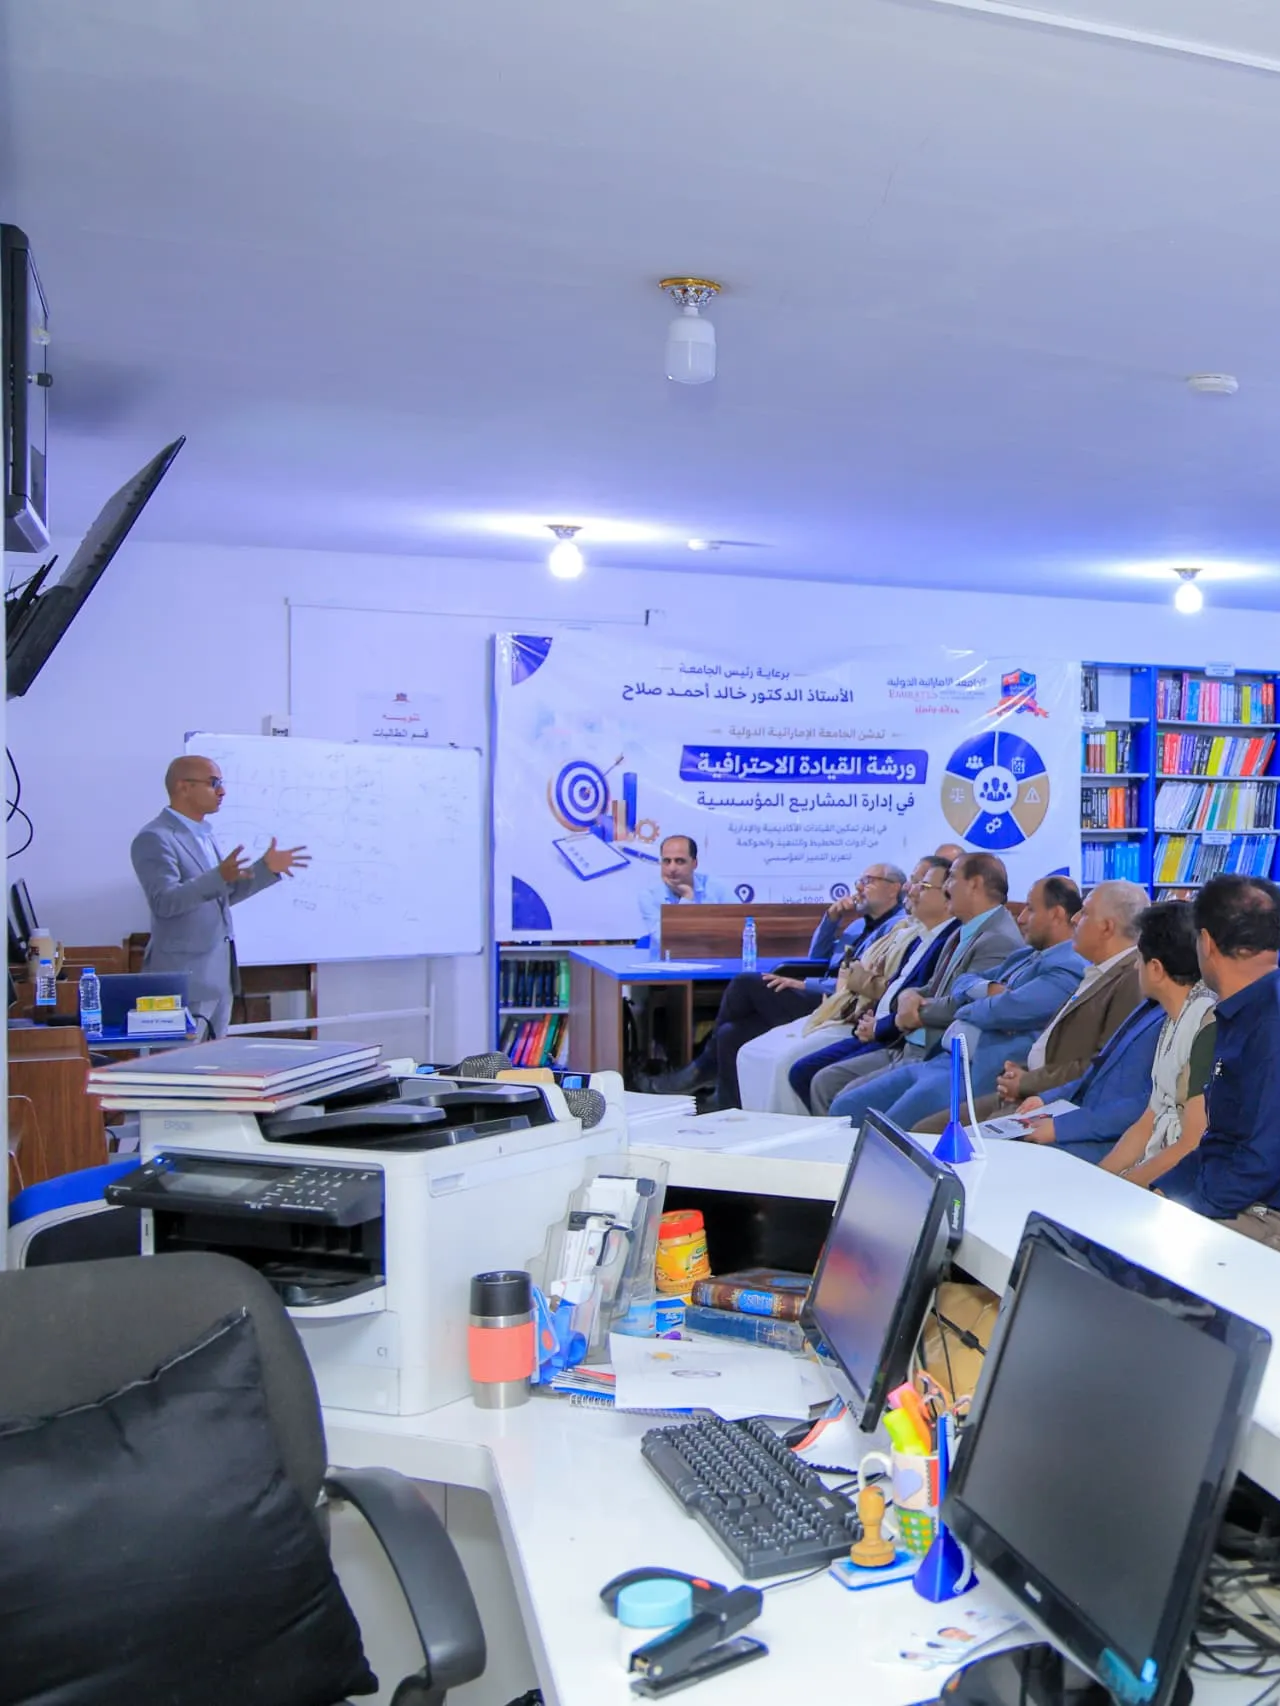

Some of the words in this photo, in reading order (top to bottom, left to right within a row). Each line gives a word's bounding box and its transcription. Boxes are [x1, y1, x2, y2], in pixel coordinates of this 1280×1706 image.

[679, 663, 721, 676] الجامعة
[724, 666, 753, 679] رئيس
[756, 668, 790, 680] برعاية
[622, 681, 662, 701] صلاح
[667, 682, 709, 699] أحمد
[714, 684, 747, 700] خالد
[750, 686, 802, 704] الدكتور
[807, 689, 854, 703] الأستاذ
[728, 725, 765, 739] الدولية
[819, 727, 855, 740] الجامعة
[697, 752, 796, 779] الاحترافية
[799, 755, 861, 781] القيادة
[866, 756, 917, 781] ورشة
[697, 791, 785, 812] المؤسسية
[788, 793, 857, 812] المشاريع
[862, 793, 893, 812] إدارة
[896, 791, 915, 816] في
[877, 825, 887, 835] في
